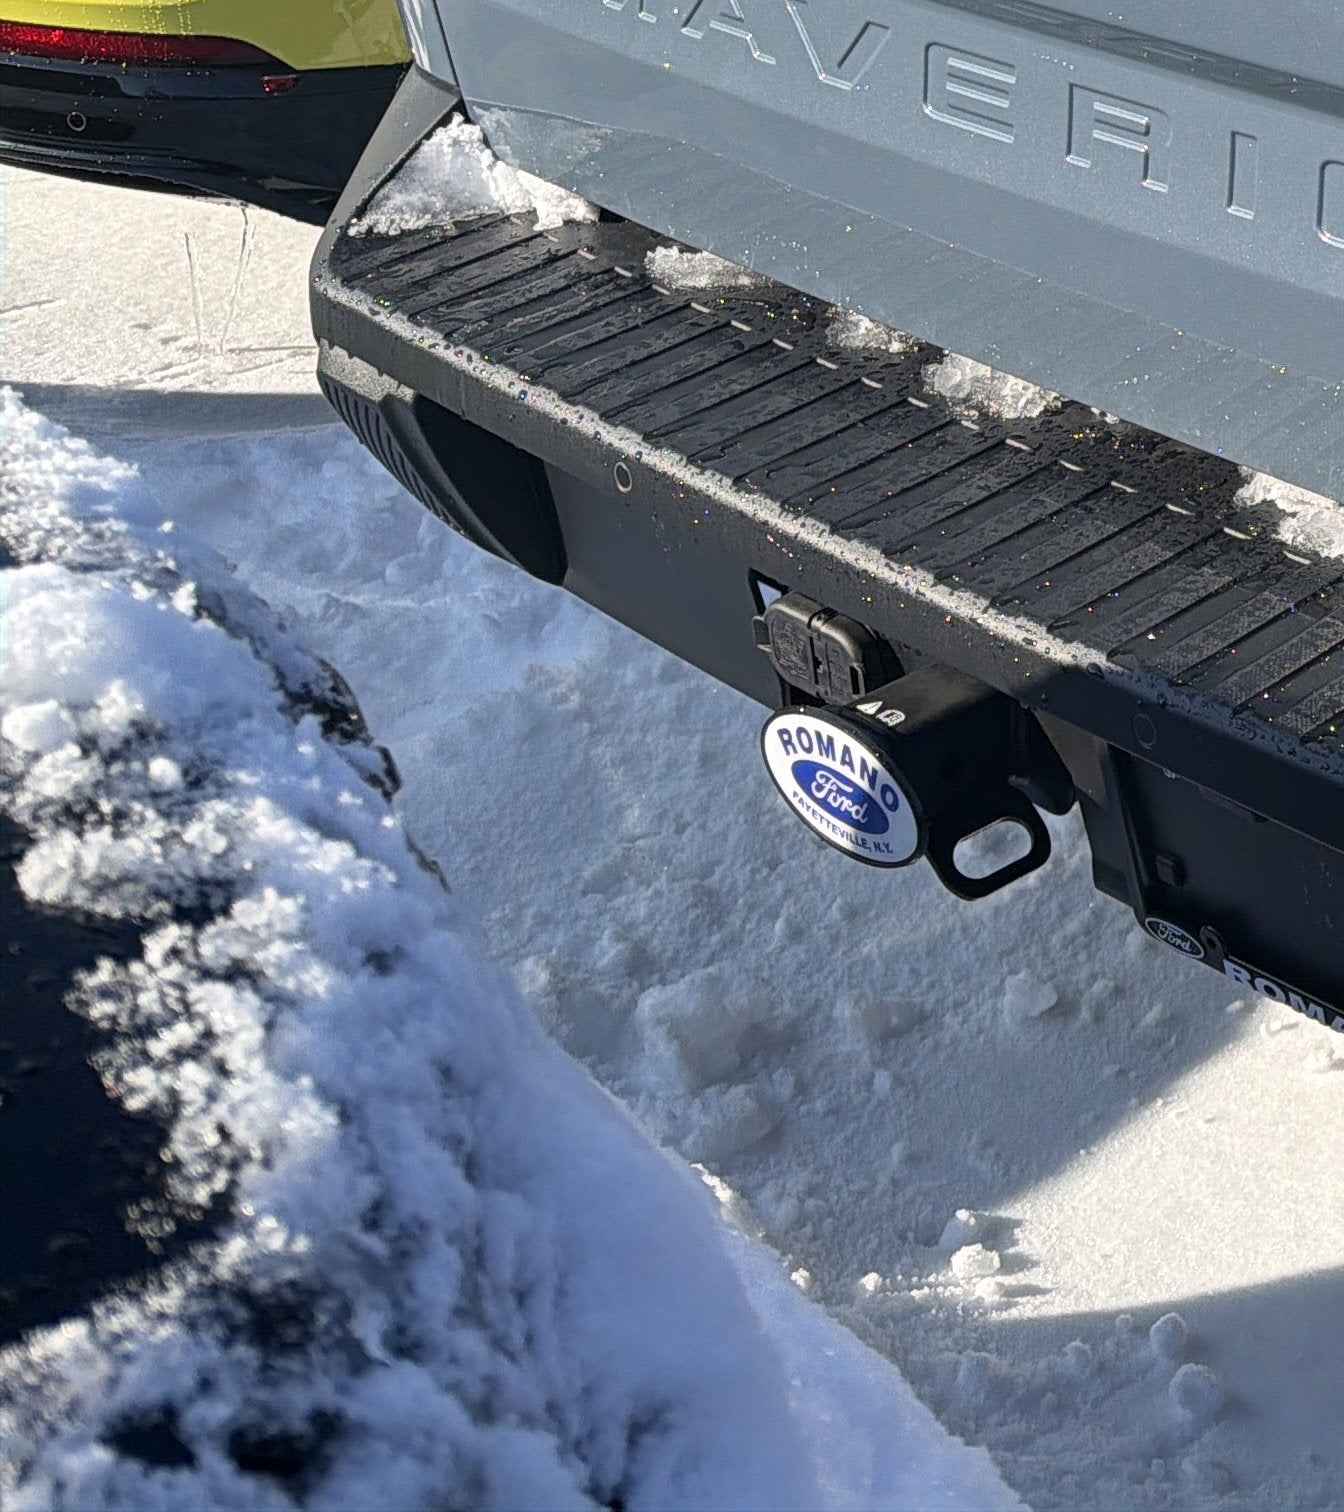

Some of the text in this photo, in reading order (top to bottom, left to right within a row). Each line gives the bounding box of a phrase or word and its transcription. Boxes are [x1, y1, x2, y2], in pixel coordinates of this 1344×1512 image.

[776, 726, 899, 813] ROMANO
[811, 770, 868, 823] Ford
[873, 840, 893, 855] N.Y.
[1156, 921, 1193, 953] Ford
